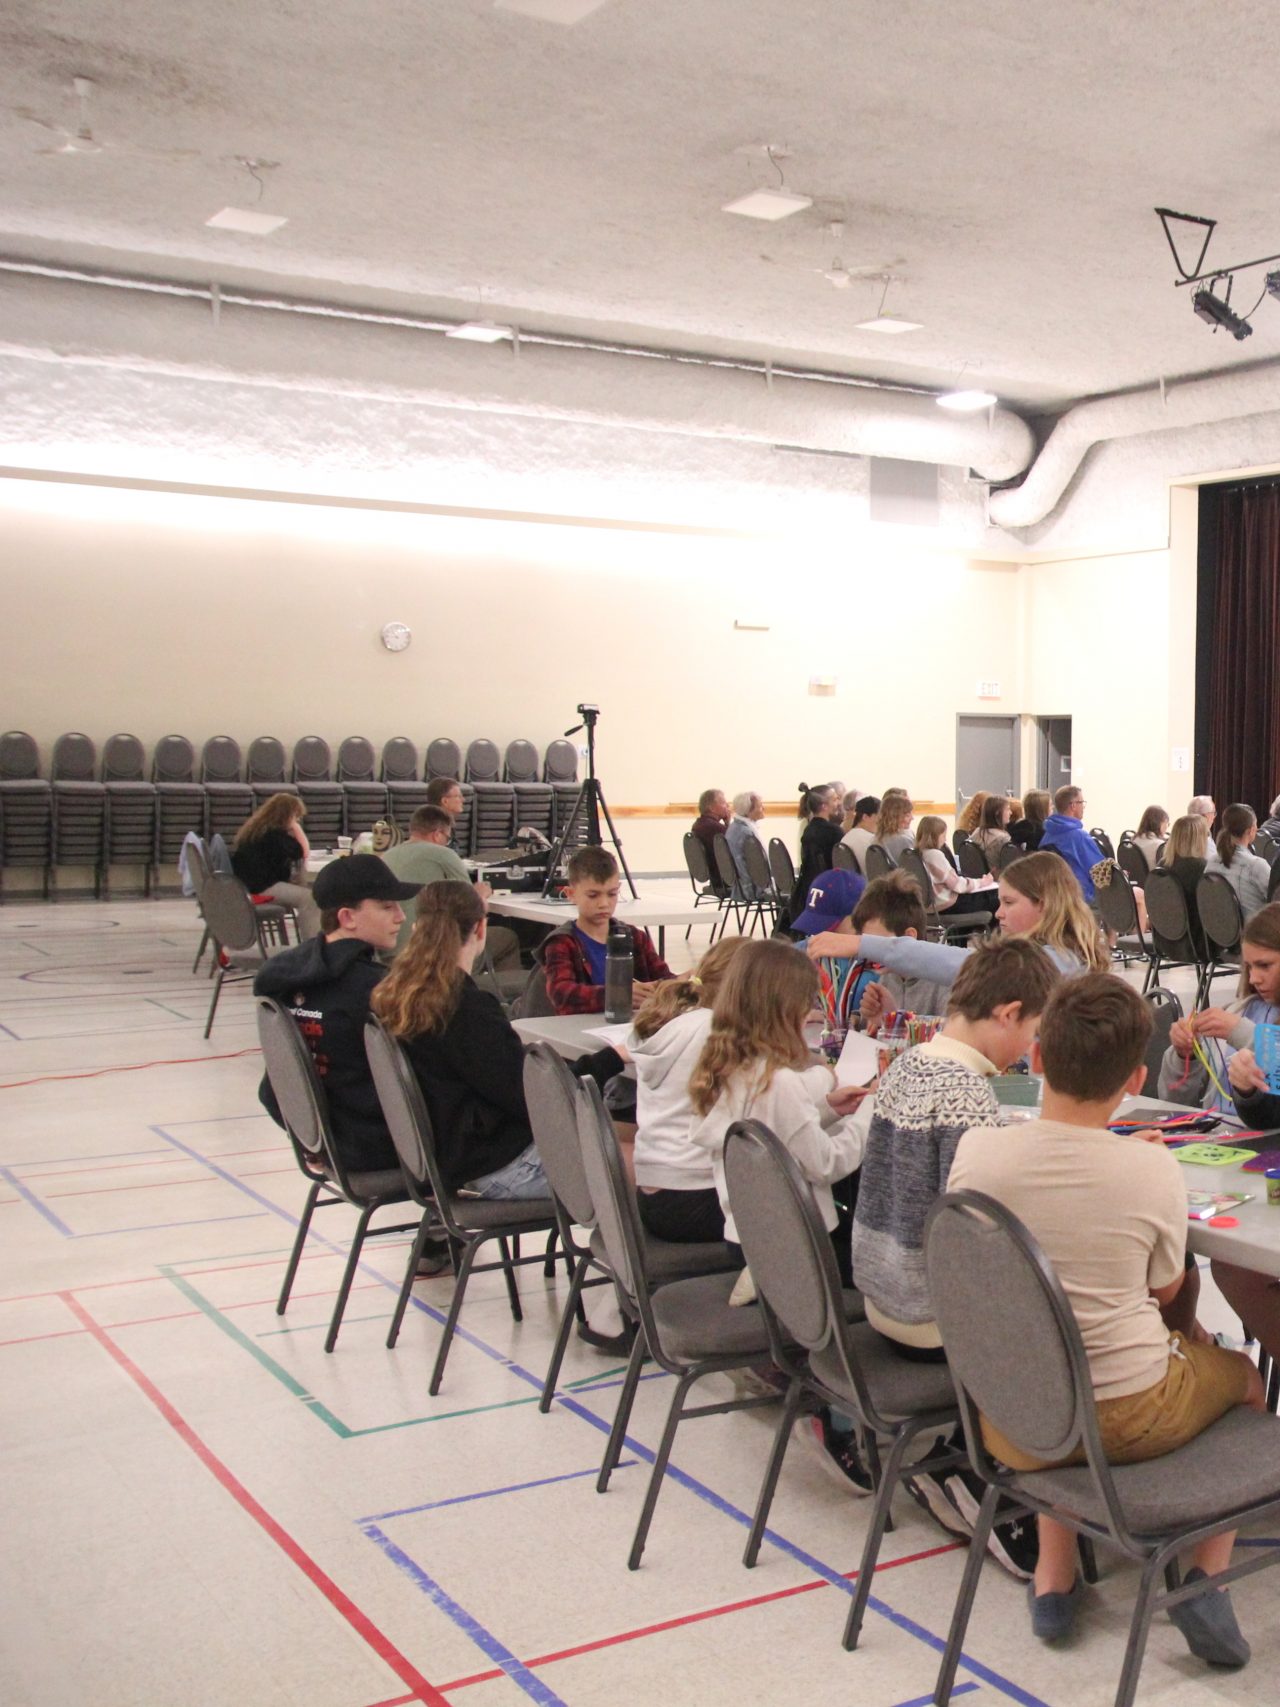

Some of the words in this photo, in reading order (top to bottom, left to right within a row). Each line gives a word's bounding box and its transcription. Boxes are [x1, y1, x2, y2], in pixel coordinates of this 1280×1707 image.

[981, 682, 1000, 695] EXIT
[808, 887, 824, 908] T
[297, 1008, 322, 1019] Canada
